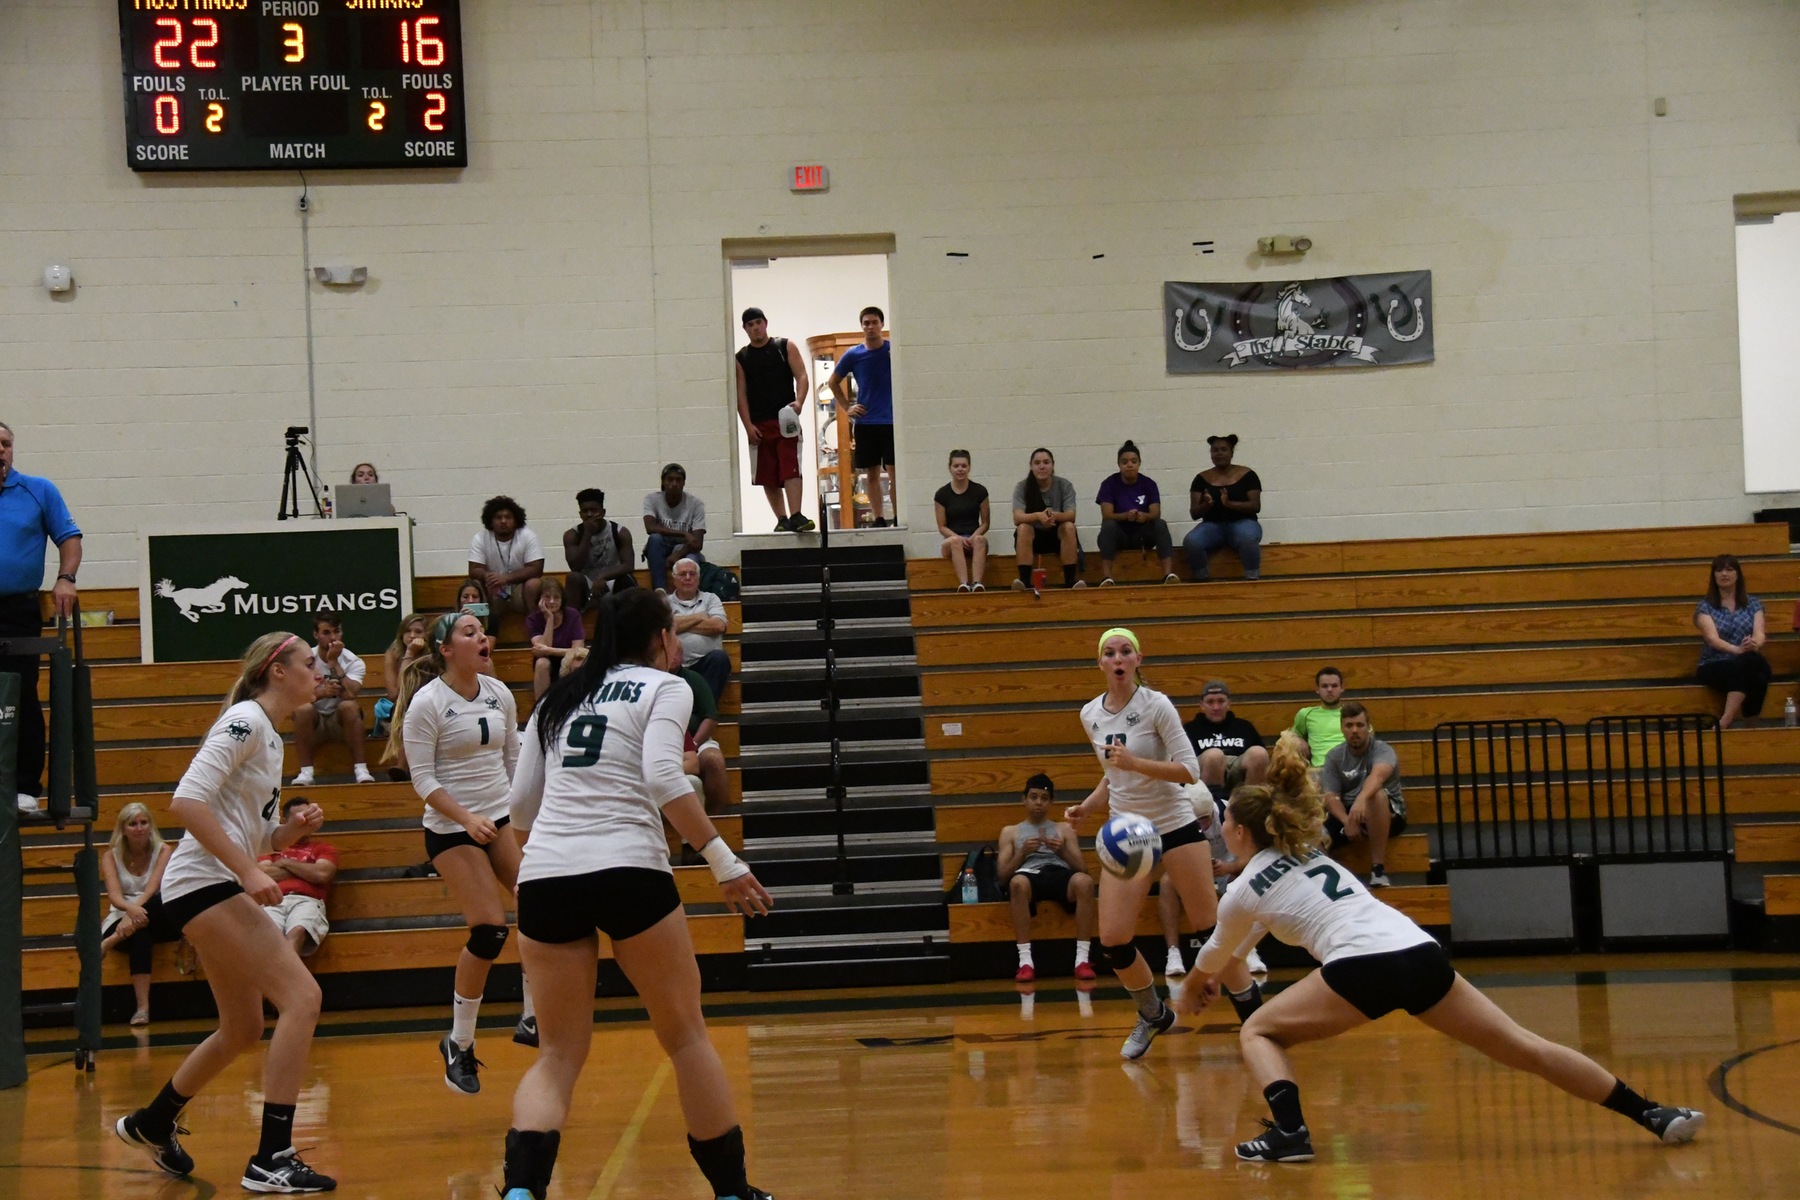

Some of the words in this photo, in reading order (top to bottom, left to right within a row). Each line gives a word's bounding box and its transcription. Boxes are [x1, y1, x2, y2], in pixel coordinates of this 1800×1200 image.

[262, 1, 319, 16] PERIOD
[155, 18, 218, 68] 22
[282, 23, 305, 63] 3
[402, 17, 444, 65] 16
[133, 76, 186, 92] FOULS
[242, 76, 303, 91] PLAYER
[310, 75, 350, 90] FOUL
[402, 74, 452, 89] FOULS
[198, 88, 230, 101] T.O.L.
[361, 87, 392, 99] T.O.L.
[155, 95, 179, 134] 0
[206, 103, 224, 132] 2
[368, 101, 386, 131] 2
[424, 93, 446, 131] 2
[136, 145, 189, 160] SCORE
[269, 143, 326, 158] MATCH
[404, 141, 455, 157] SCORE
[794, 166, 822, 188] EXIT
[1239, 338, 1271, 354] The
[1294, 334, 1355, 350] Stable
[477, 716, 489, 746] 1
[562, 714, 608, 768] 9
[1299, 861, 1347, 896] 2
